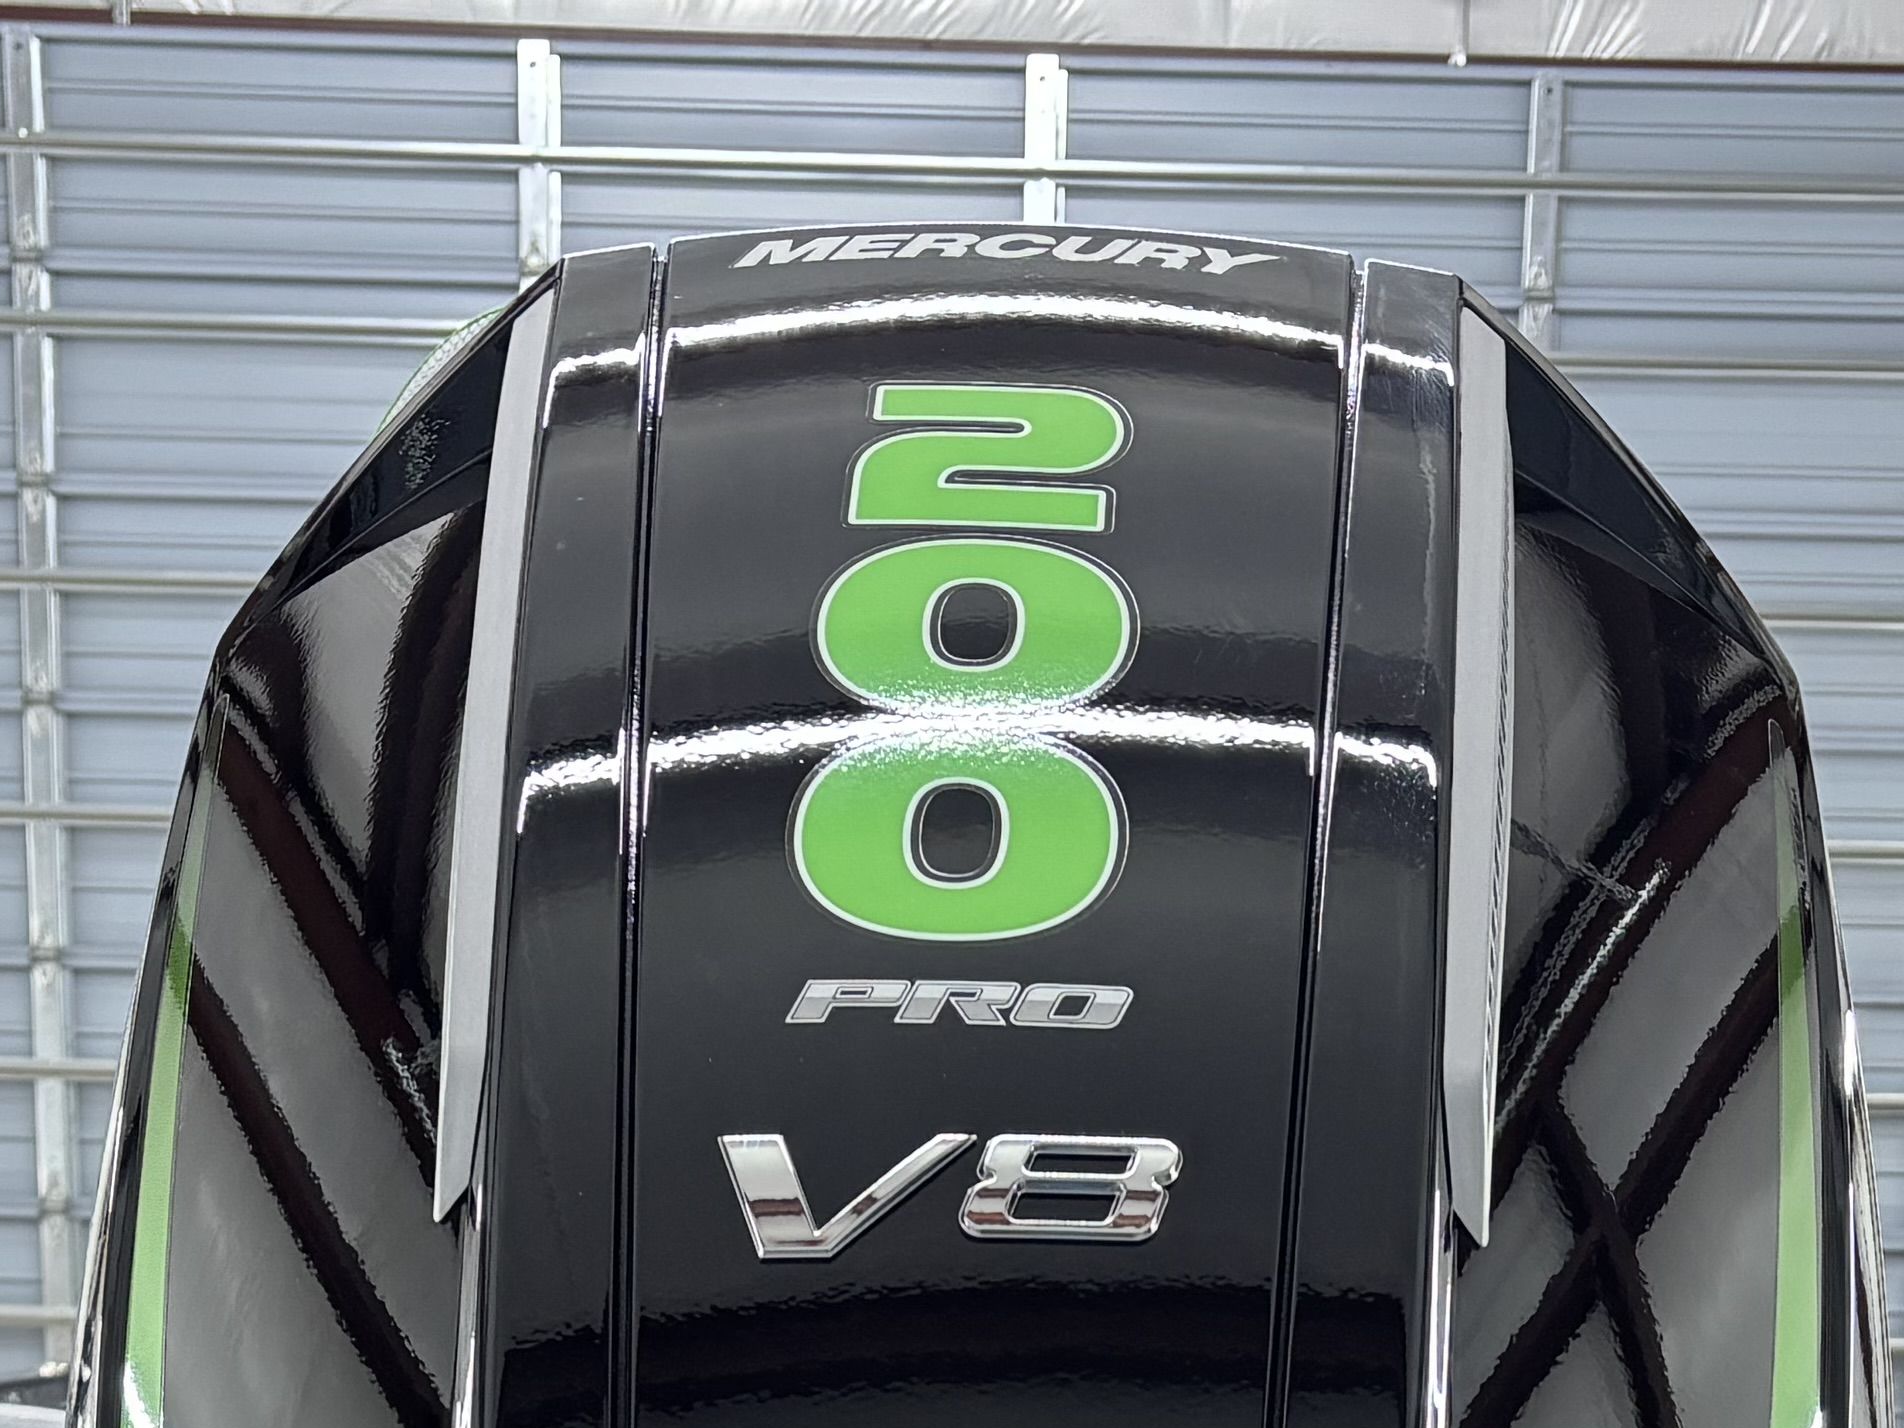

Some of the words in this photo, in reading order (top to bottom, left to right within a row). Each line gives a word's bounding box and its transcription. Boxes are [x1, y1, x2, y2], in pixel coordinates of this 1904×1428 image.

[731, 232, 1283, 275] MERCURY
[792, 383, 1132, 942] 200
[785, 978, 1134, 1029] PRO
[718, 1132, 1184, 1259] V8
